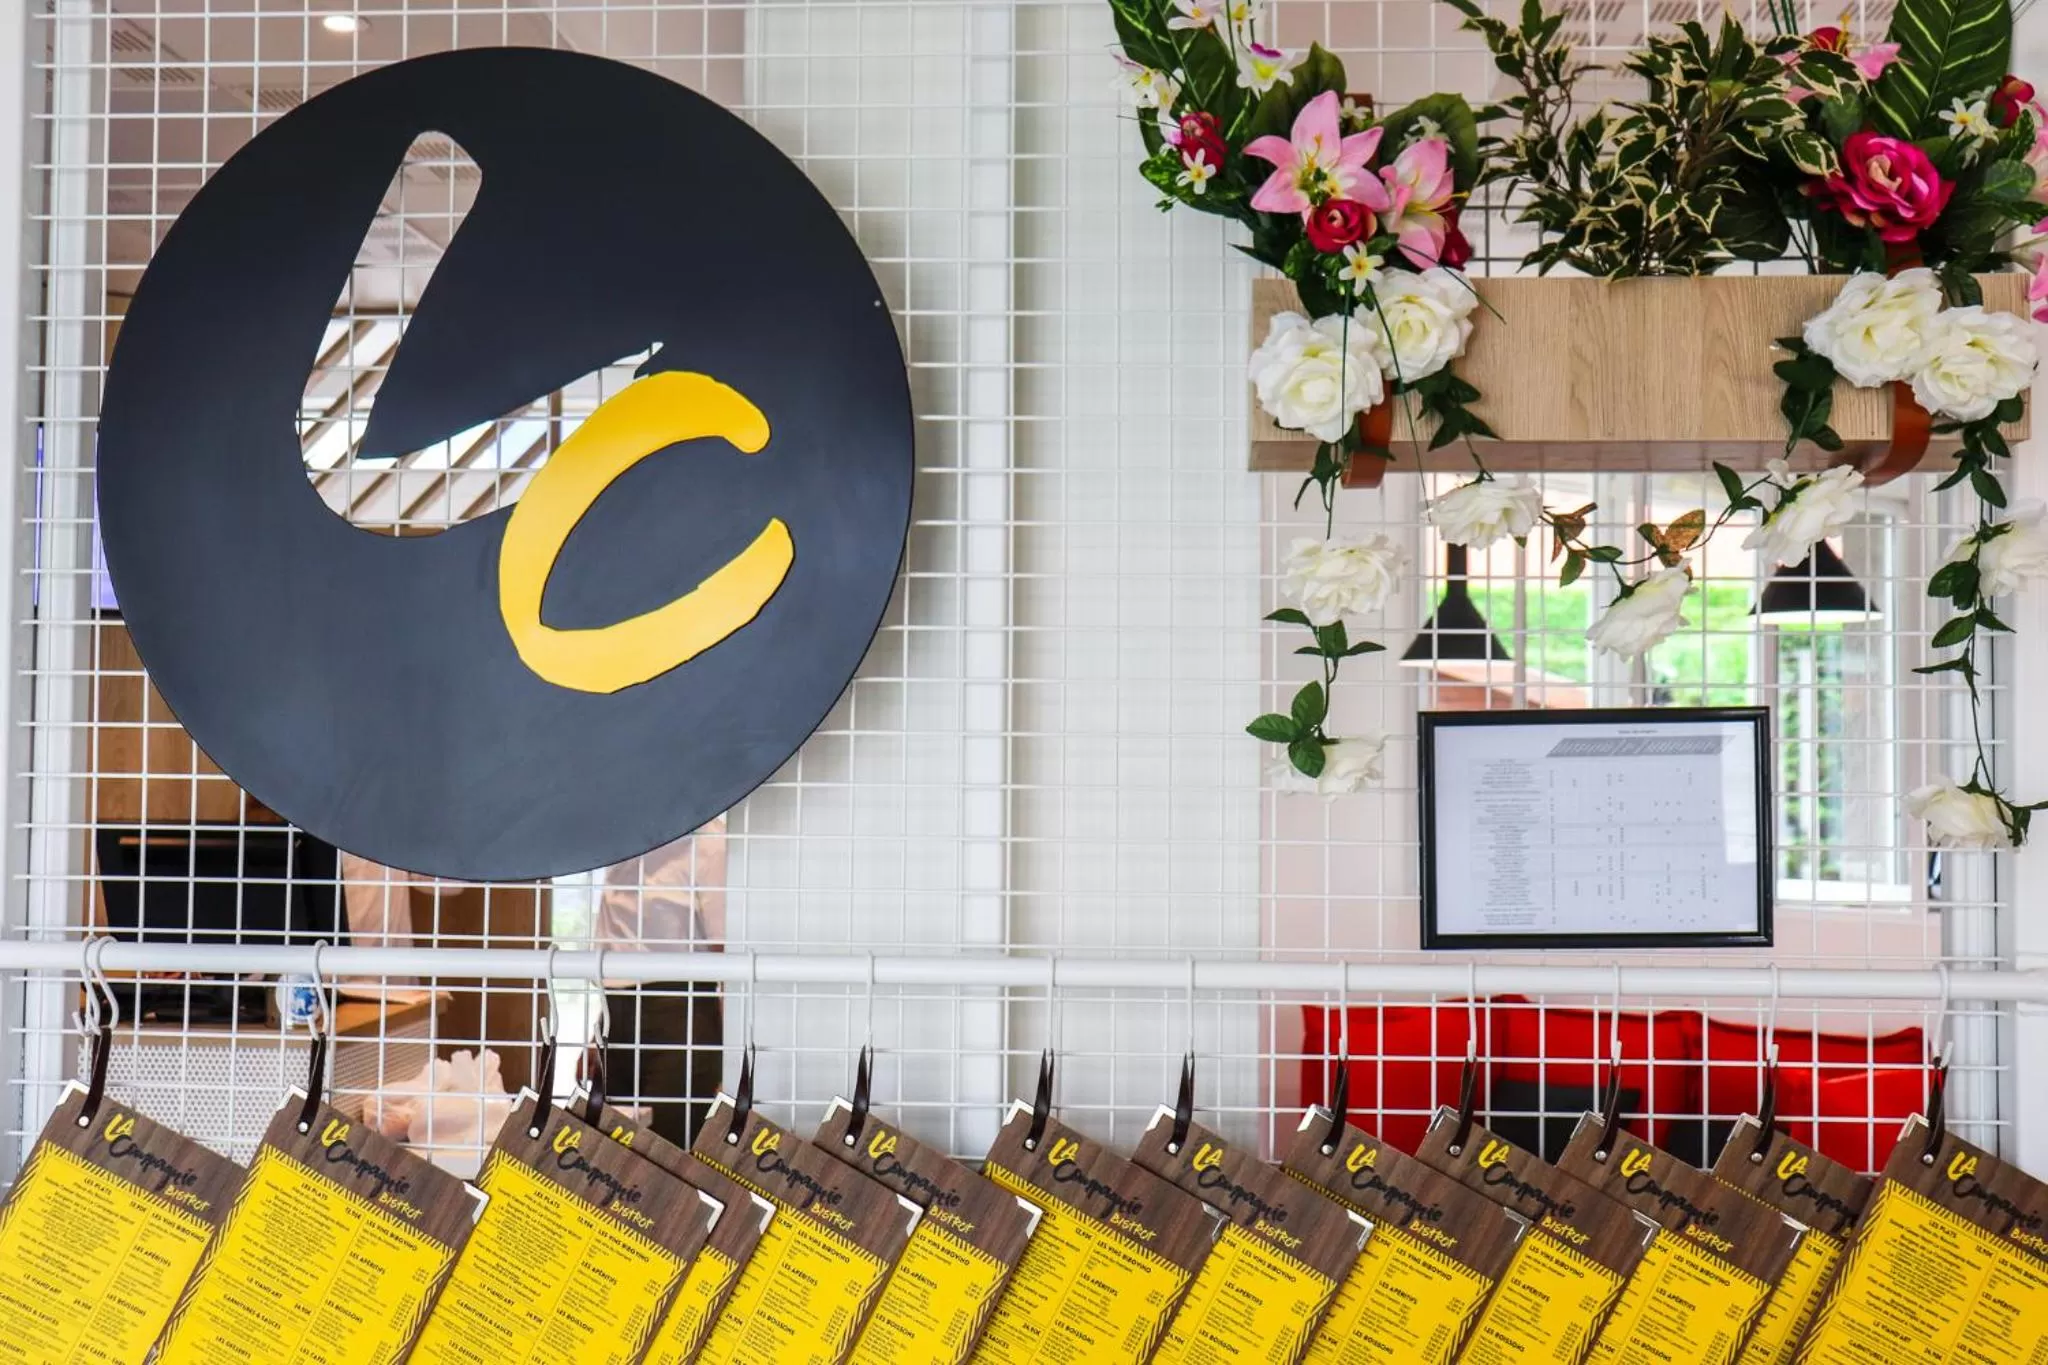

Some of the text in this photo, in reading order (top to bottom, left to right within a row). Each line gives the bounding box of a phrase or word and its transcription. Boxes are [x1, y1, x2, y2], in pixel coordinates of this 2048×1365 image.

[104, 1114, 135, 1141] LA
[321, 1119, 350, 1146] LA
[553, 1126, 582, 1153] LA
[752, 1128, 780, 1155] LA
[868, 1130, 897, 1158] LA
[1048, 1138, 1078, 1165] LA
[1193, 1143, 1223, 1171] LA
[1346, 1144, 1377, 1172] LA
[1478, 1140, 1509, 1168] LA
[1621, 1149, 1651, 1177] LA
[1777, 1151, 1808, 1179] LA
[1948, 1152, 1977, 1180] LA
[2010, 1226, 2048, 1256] BISTRO
